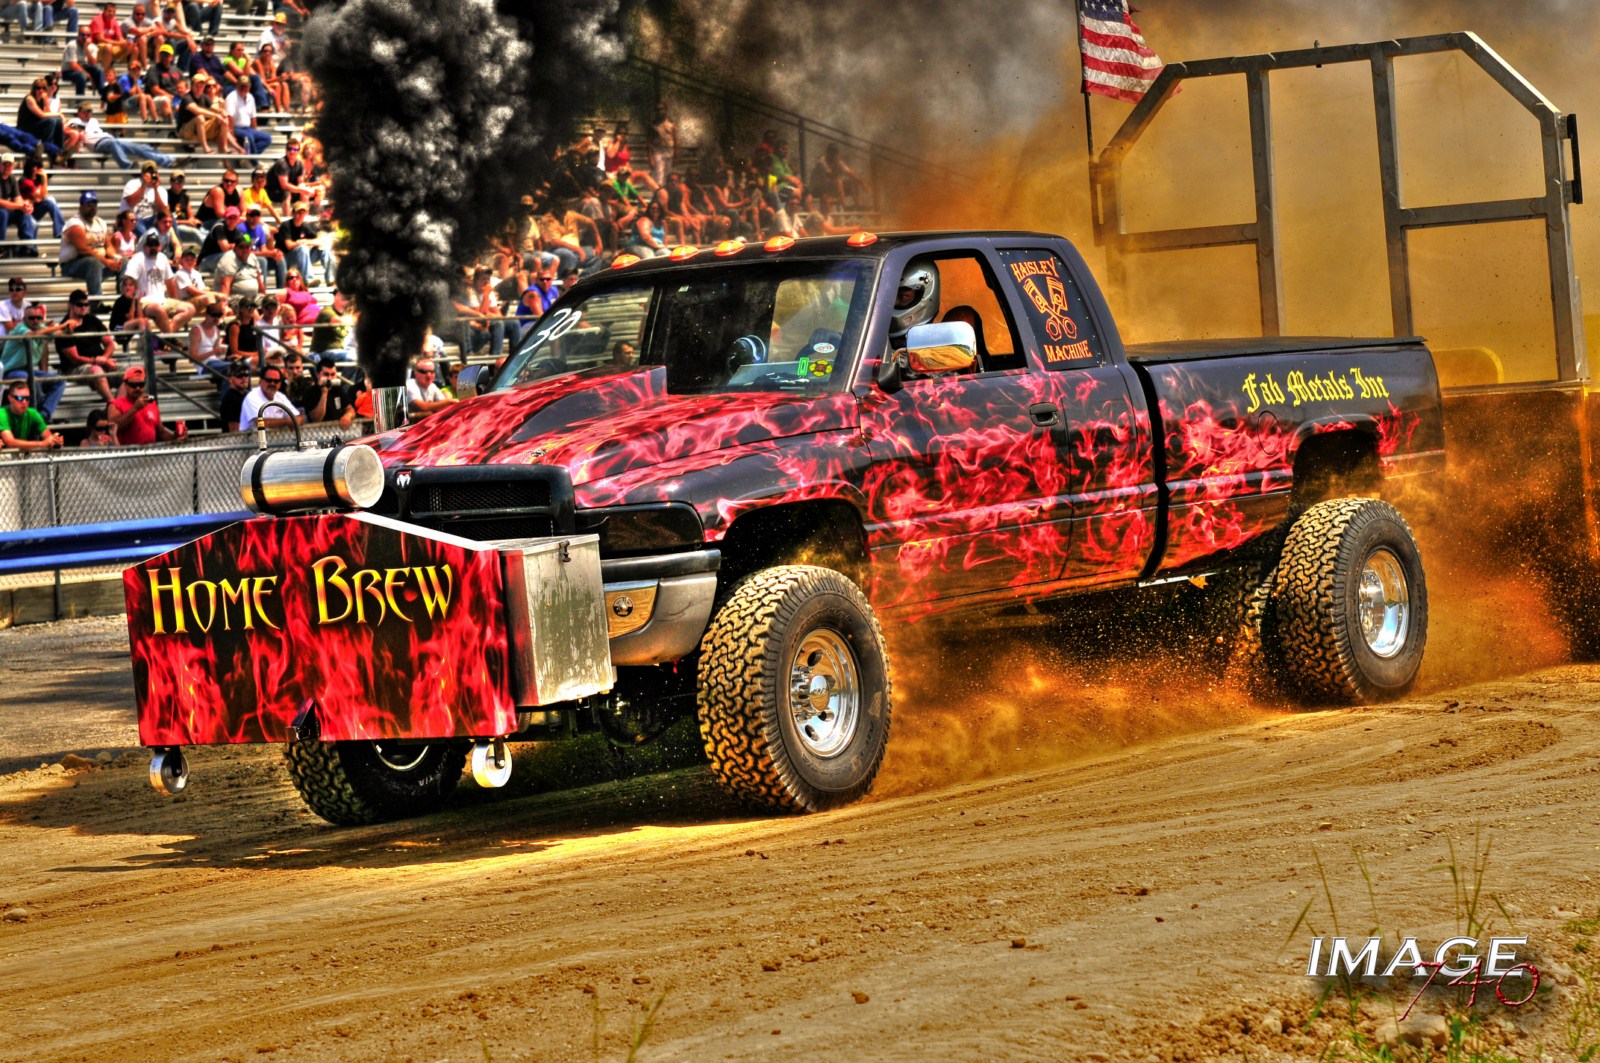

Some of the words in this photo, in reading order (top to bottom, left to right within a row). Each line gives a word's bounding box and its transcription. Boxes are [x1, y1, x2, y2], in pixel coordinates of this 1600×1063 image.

[1010, 257, 1059, 283] HAISLEY
[1044, 340, 1093, 362] MACHINE
[1242, 373, 1285, 413] Fab
[1287, 370, 1354, 407] Metals
[1350, 367, 1389, 399] Inc
[147, 567, 281, 634] HOME
[312, 555, 453, 627] BREW
